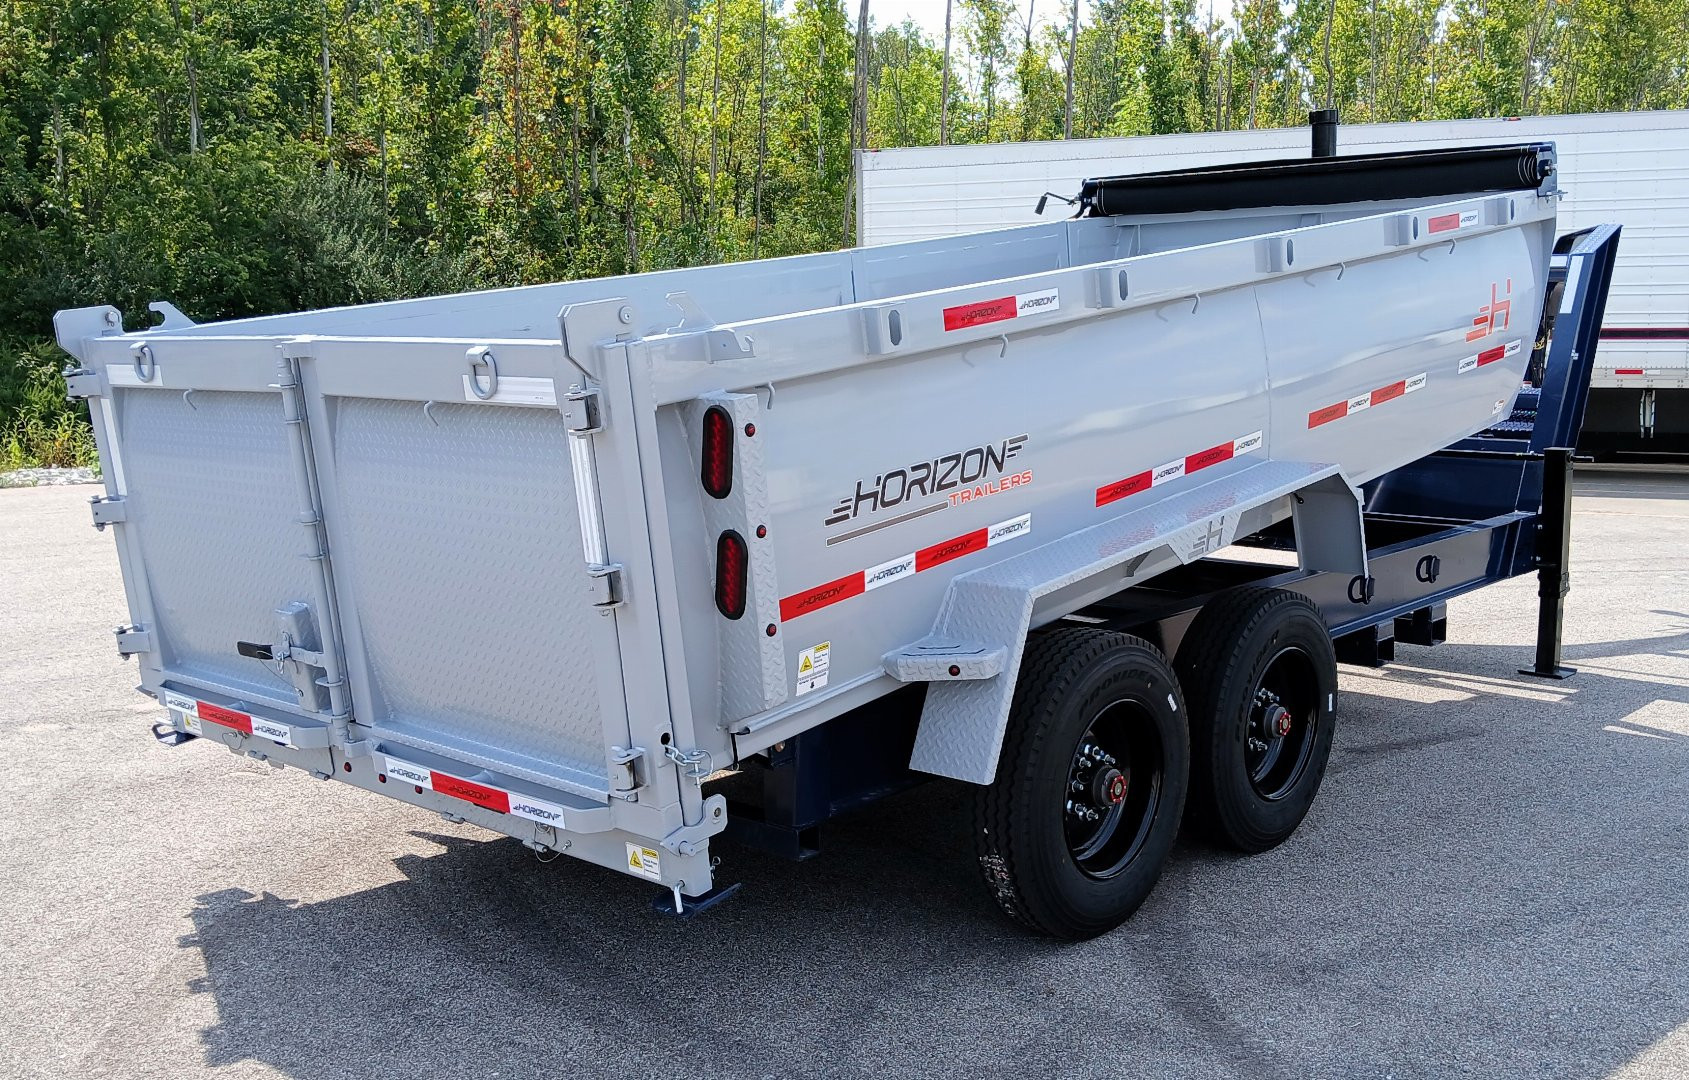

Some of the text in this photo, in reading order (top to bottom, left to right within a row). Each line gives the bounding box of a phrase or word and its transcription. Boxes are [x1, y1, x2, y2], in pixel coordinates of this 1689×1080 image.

[852, 440, 1008, 518] HORIZON
[948, 470, 1033, 506] TRAILERS
[801, 521, 1025, 608] HORIZON HORIZON HORIZON HORIZON
[257, 725, 284, 738] HORIZON
[392, 767, 556, 821] HORIZON HORIZON HORIZON
